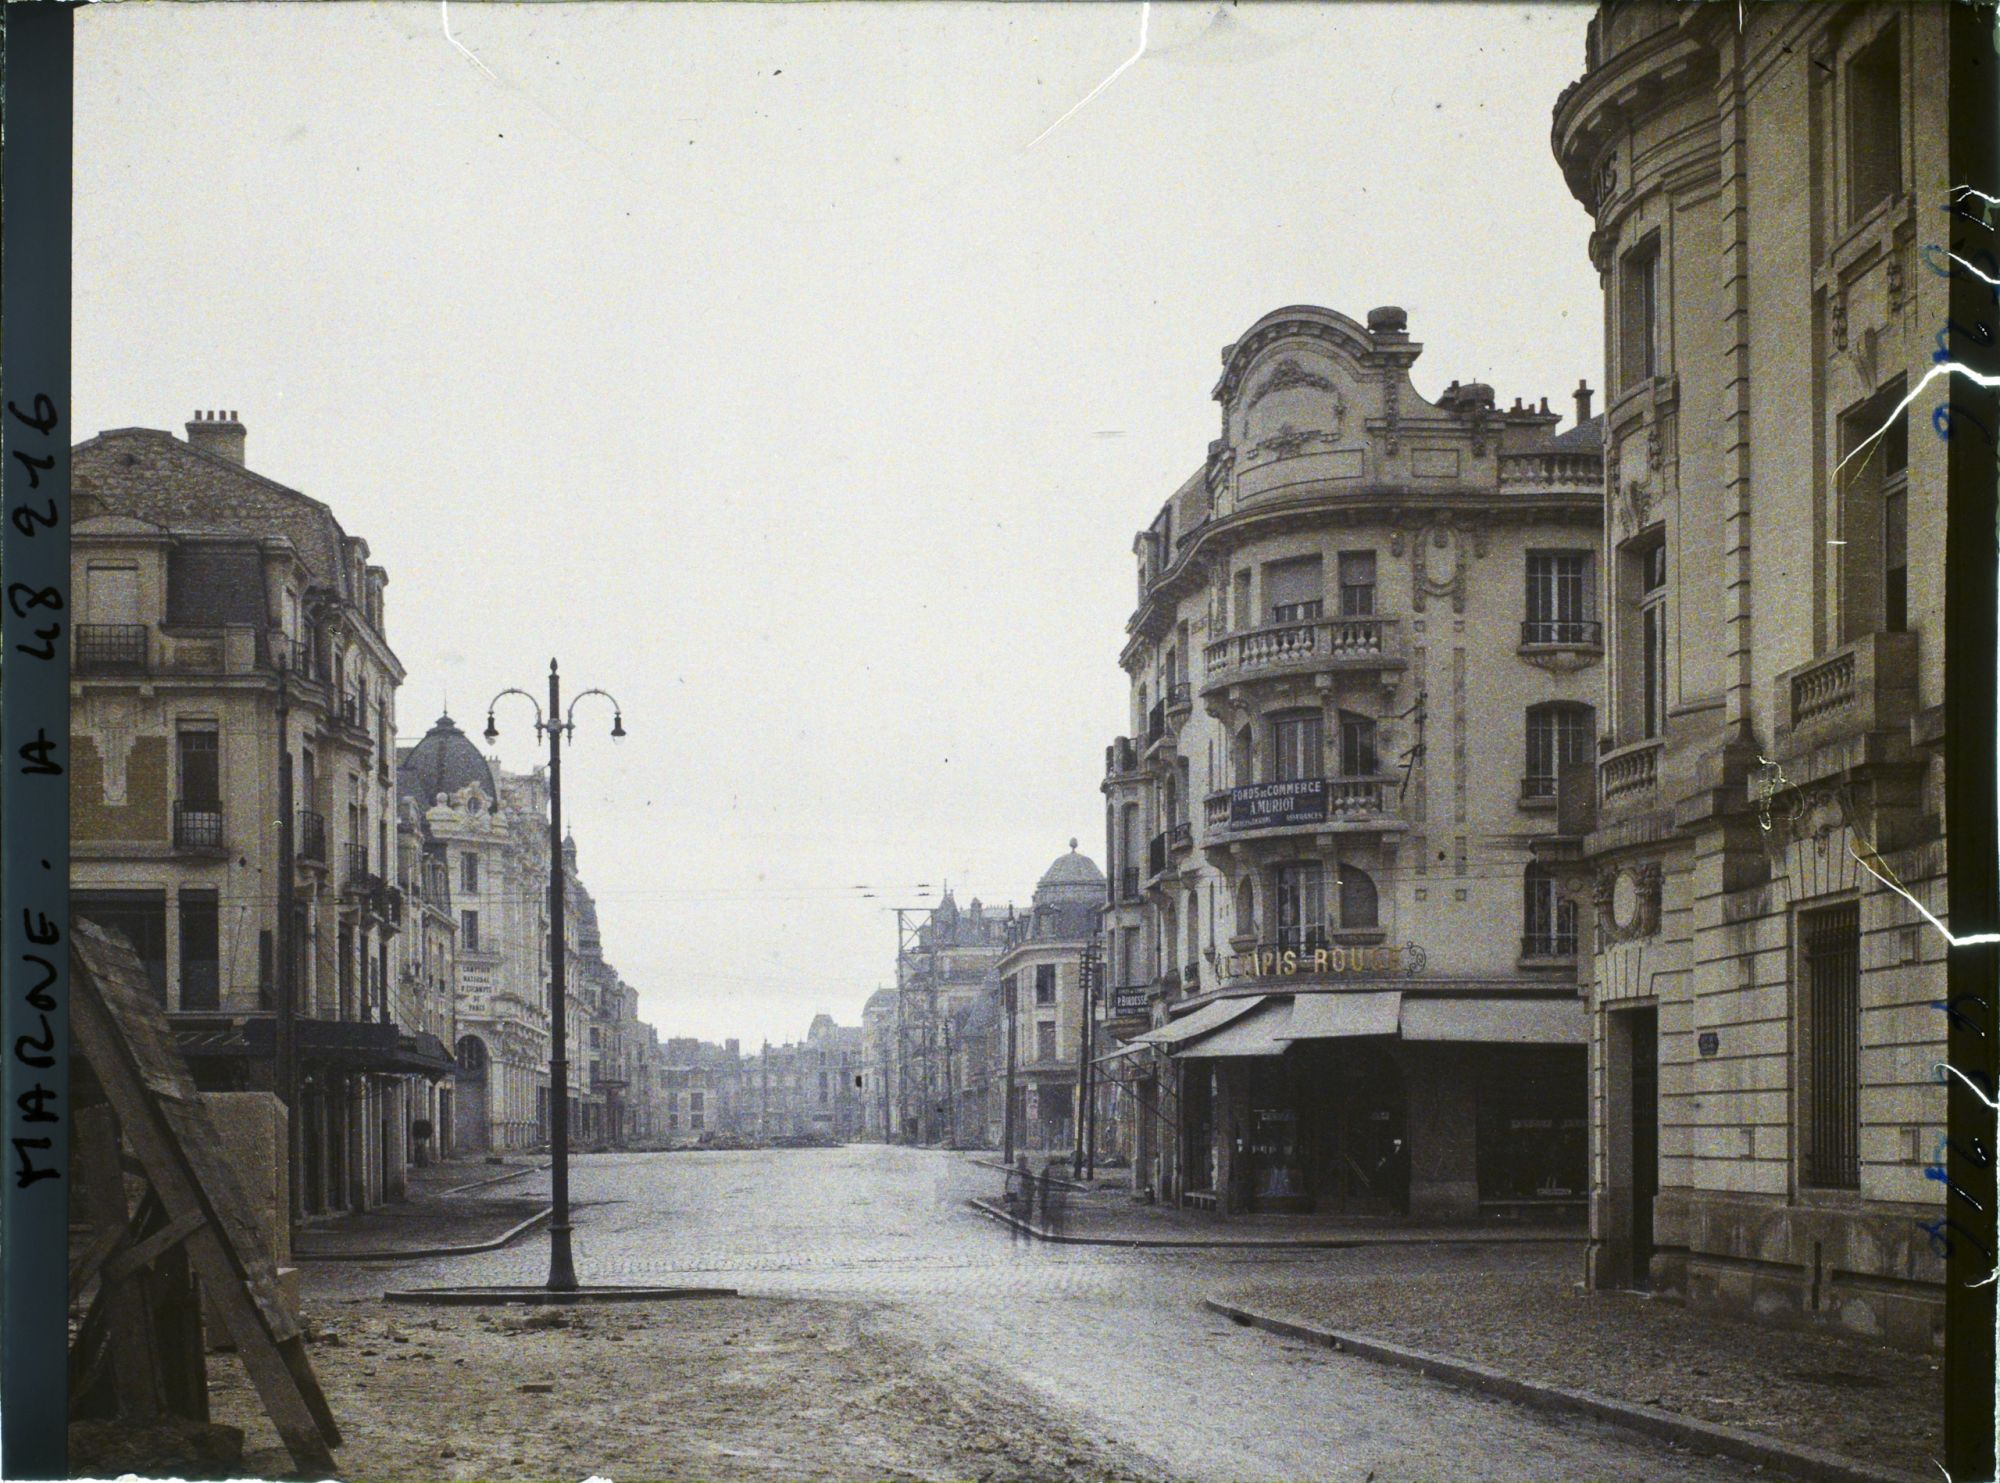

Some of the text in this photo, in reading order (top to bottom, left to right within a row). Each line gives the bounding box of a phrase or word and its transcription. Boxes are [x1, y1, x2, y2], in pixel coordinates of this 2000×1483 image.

[1232, 786, 1260, 802] FONDS
[1267, 780, 1322, 797] COMMERCE
[1313, 946, 1401, 974] ROUGE
